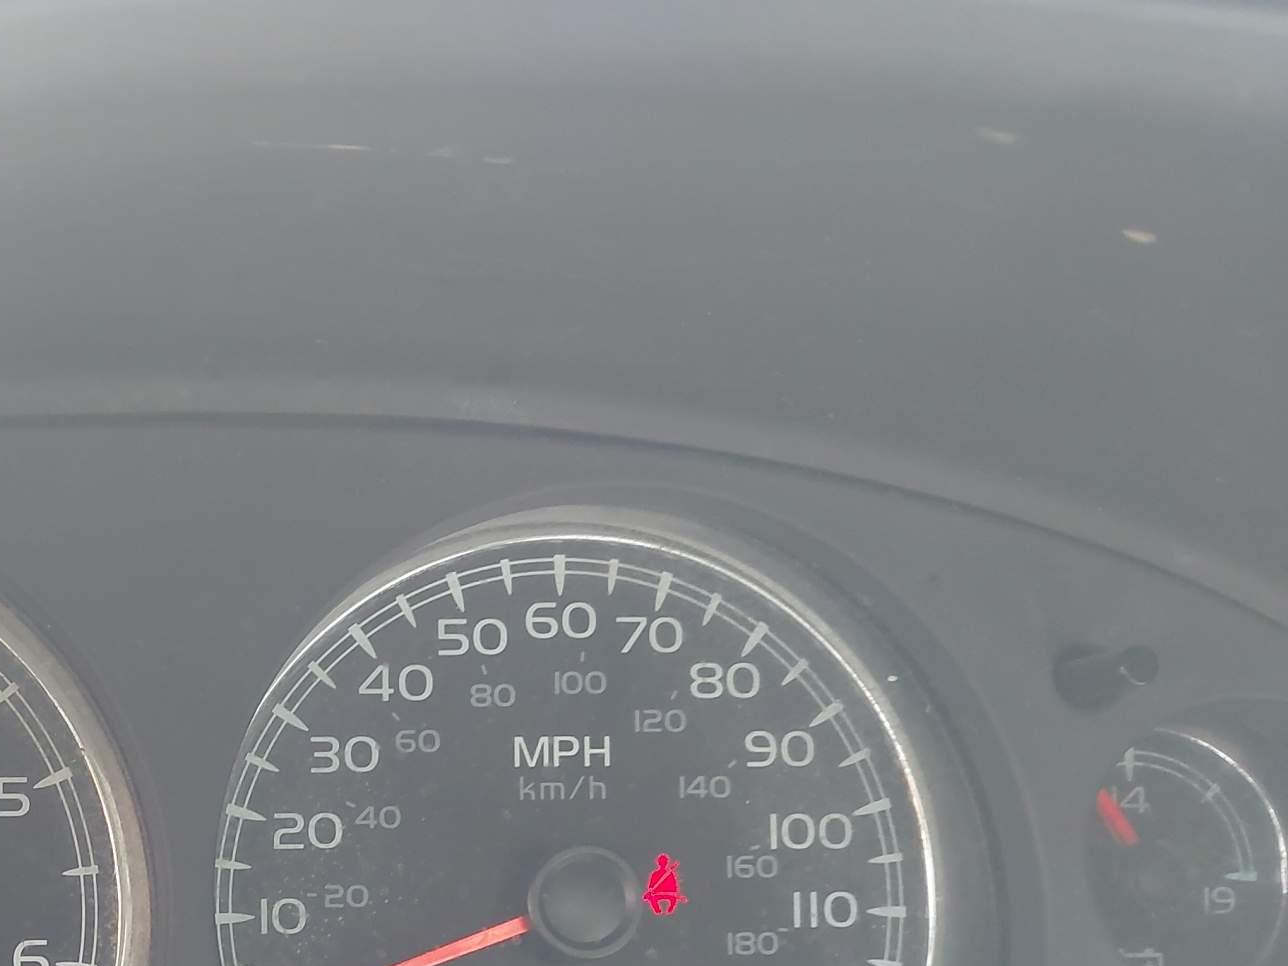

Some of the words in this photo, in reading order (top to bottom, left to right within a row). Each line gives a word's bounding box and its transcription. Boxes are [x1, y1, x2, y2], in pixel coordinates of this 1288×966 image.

[437, 618, 508, 656] 50
[525, 602, 597, 639] 60
[615, 616, 684, 654] 70
[358, 664, 434, 702] 40
[470, 683, 516, 708] 80
[554, 670, 607, 695] 100
[689, 662, 760, 699] 80
[634, 709, 687, 733] 120
[310, 736, 380, 773] 30
[395, 729, 441, 753] 60
[514, 735, 611, 768] MPH
[743, 731, 815, 768] 90
[519, 775, 607, 801] km/h
[679, 775, 731, 799] 140
[273, 812, 343, 850] 20
[354, 805, 401, 829] 40
[768, 813, 853, 850] 100
[726, 854, 779, 879] 160
[324, 884, 369, 908] 20
[793, 891, 858, 928] 110
[1203, 885, 1236, 914] 19
[260, 898, 307, 935] 10
[727, 932, 778, 956] 180
